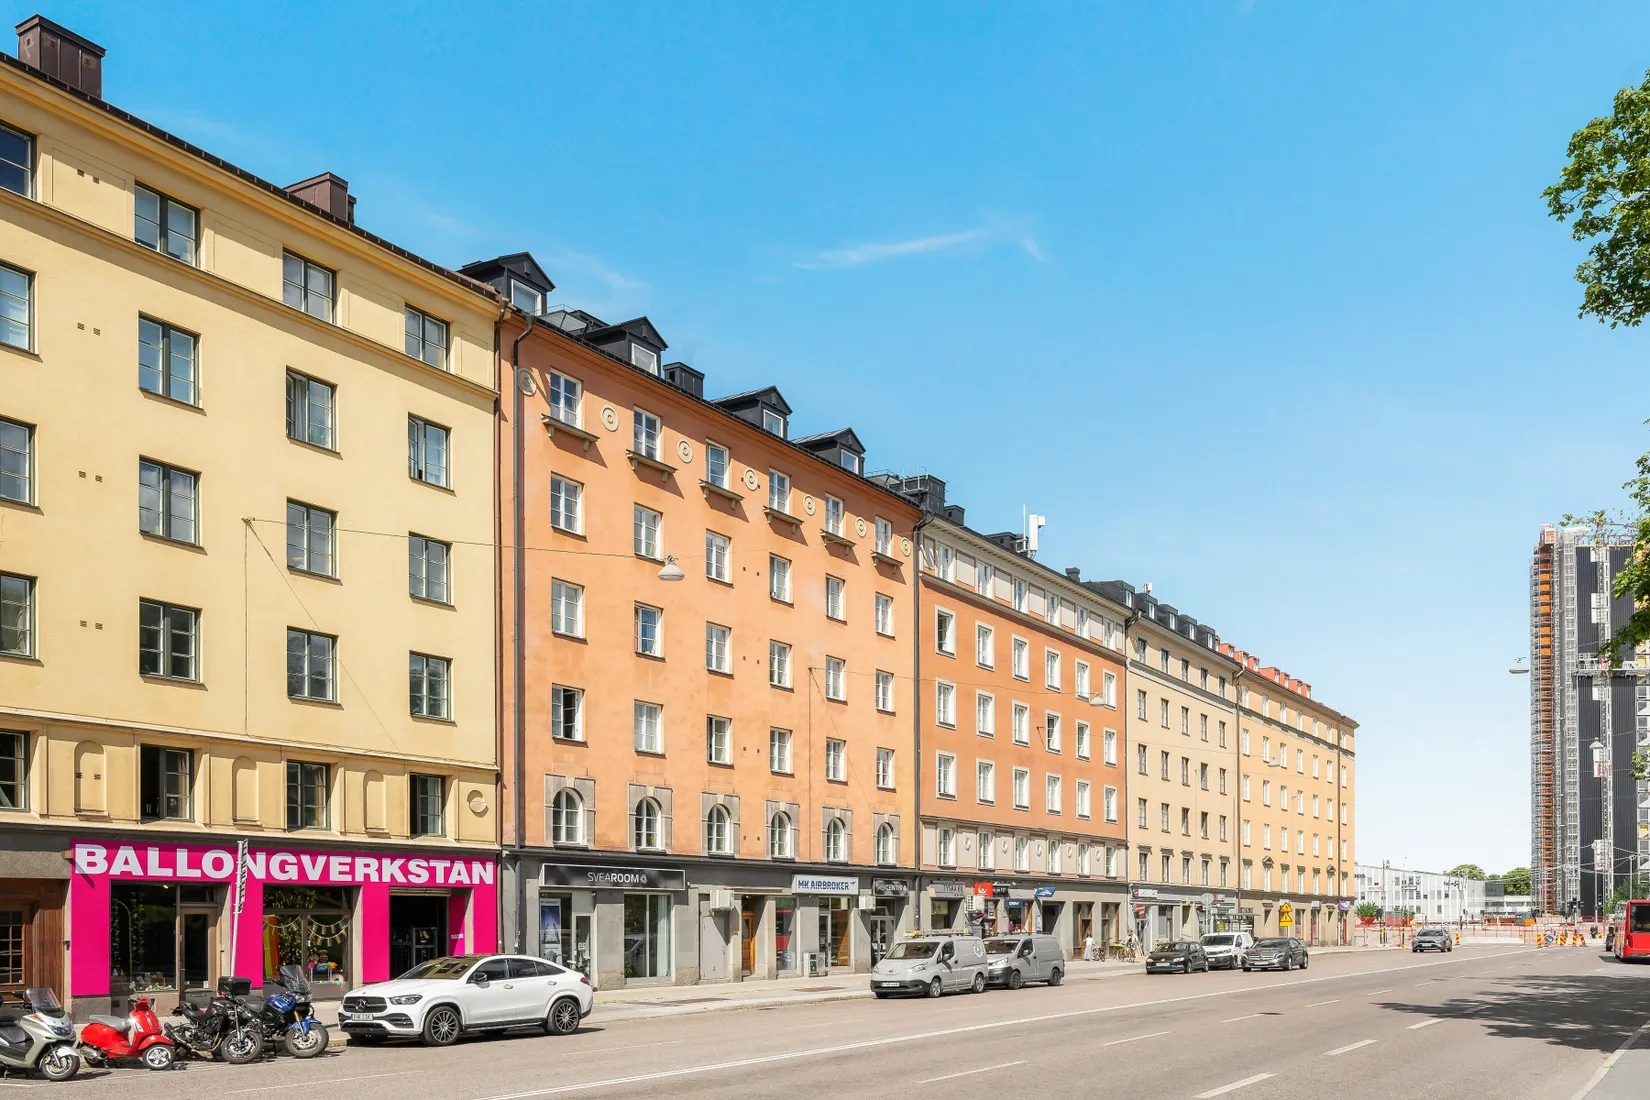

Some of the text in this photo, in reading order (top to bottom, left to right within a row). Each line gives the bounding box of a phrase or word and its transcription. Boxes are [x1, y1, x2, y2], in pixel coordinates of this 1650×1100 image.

[75, 844, 494, 884] BALLONGVERKSTAN
[587, 872, 640, 883] SVEAROOM
[811, 881, 849, 890] AIRBROKER
